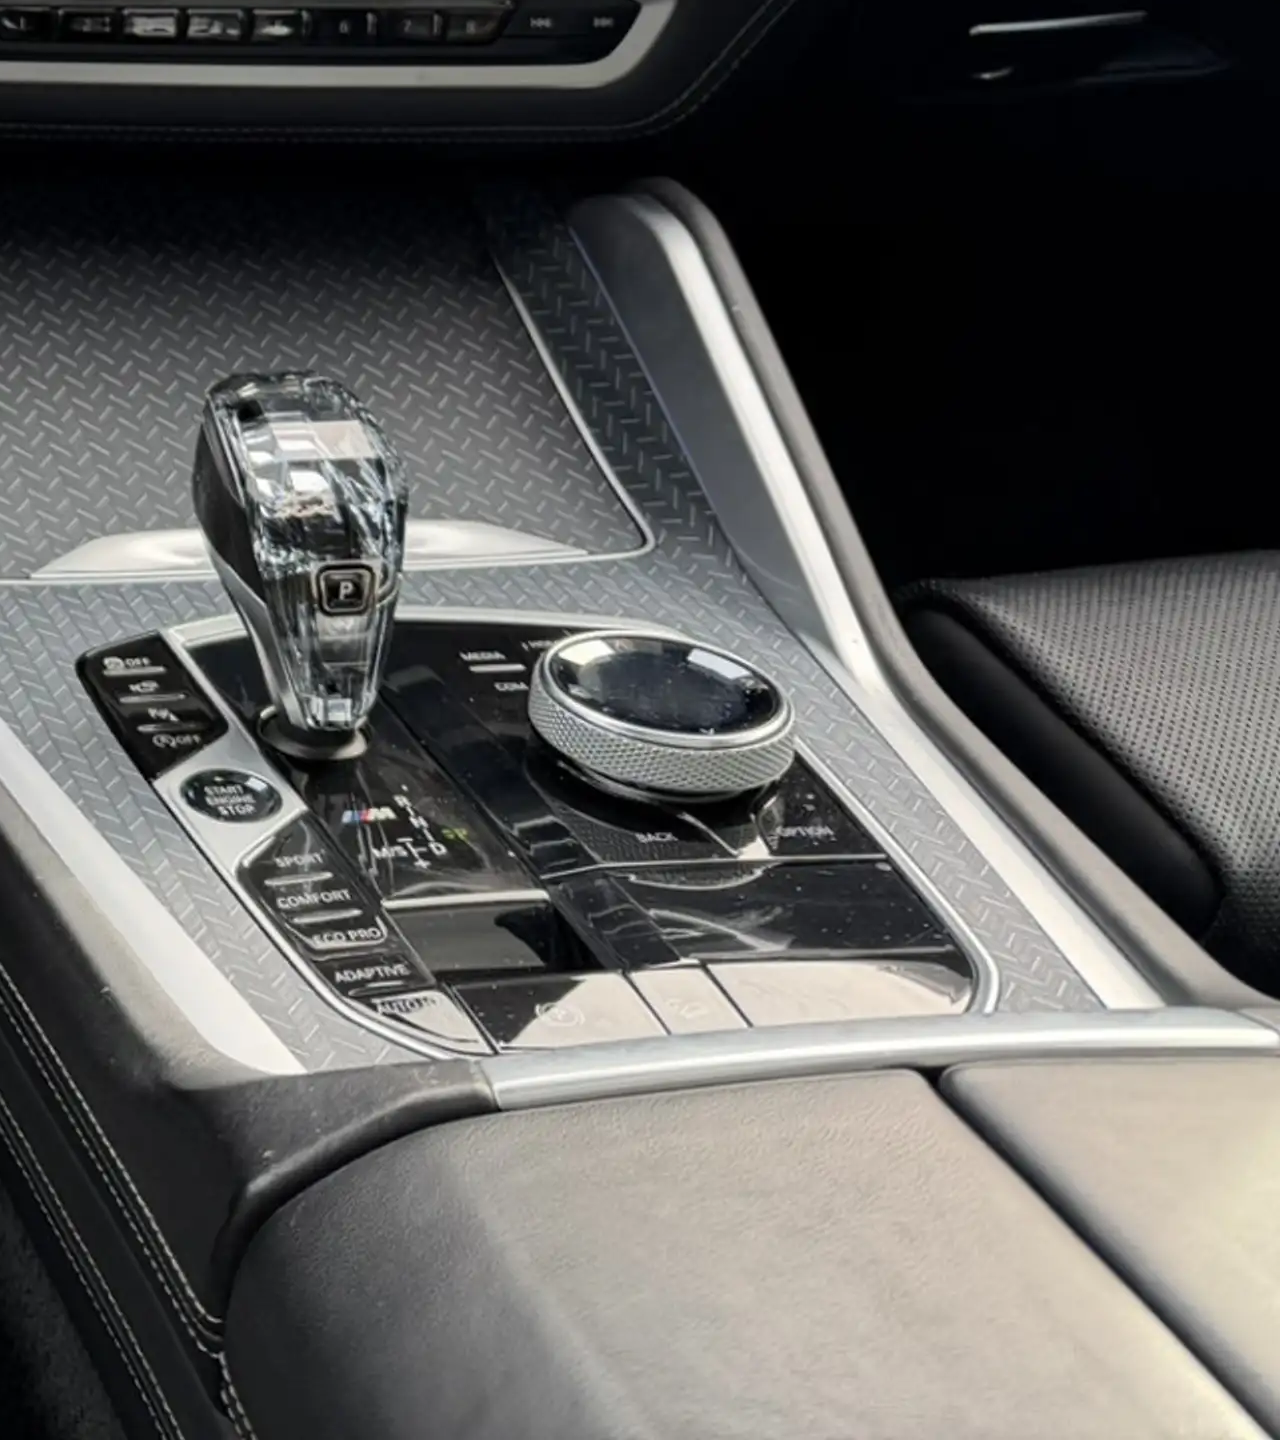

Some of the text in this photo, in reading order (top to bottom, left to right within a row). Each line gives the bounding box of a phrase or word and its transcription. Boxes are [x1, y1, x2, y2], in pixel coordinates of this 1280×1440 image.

[339, 580, 354, 601] P
[203, 784, 244, 795] START
[205, 794, 257, 806] ENGINE
[218, 804, 256, 816] STOP
[276, 888, 352, 910] COMFORT
[311, 926, 383, 946] ECO PRO
[334, 963, 411, 984] ADAPTIVE
